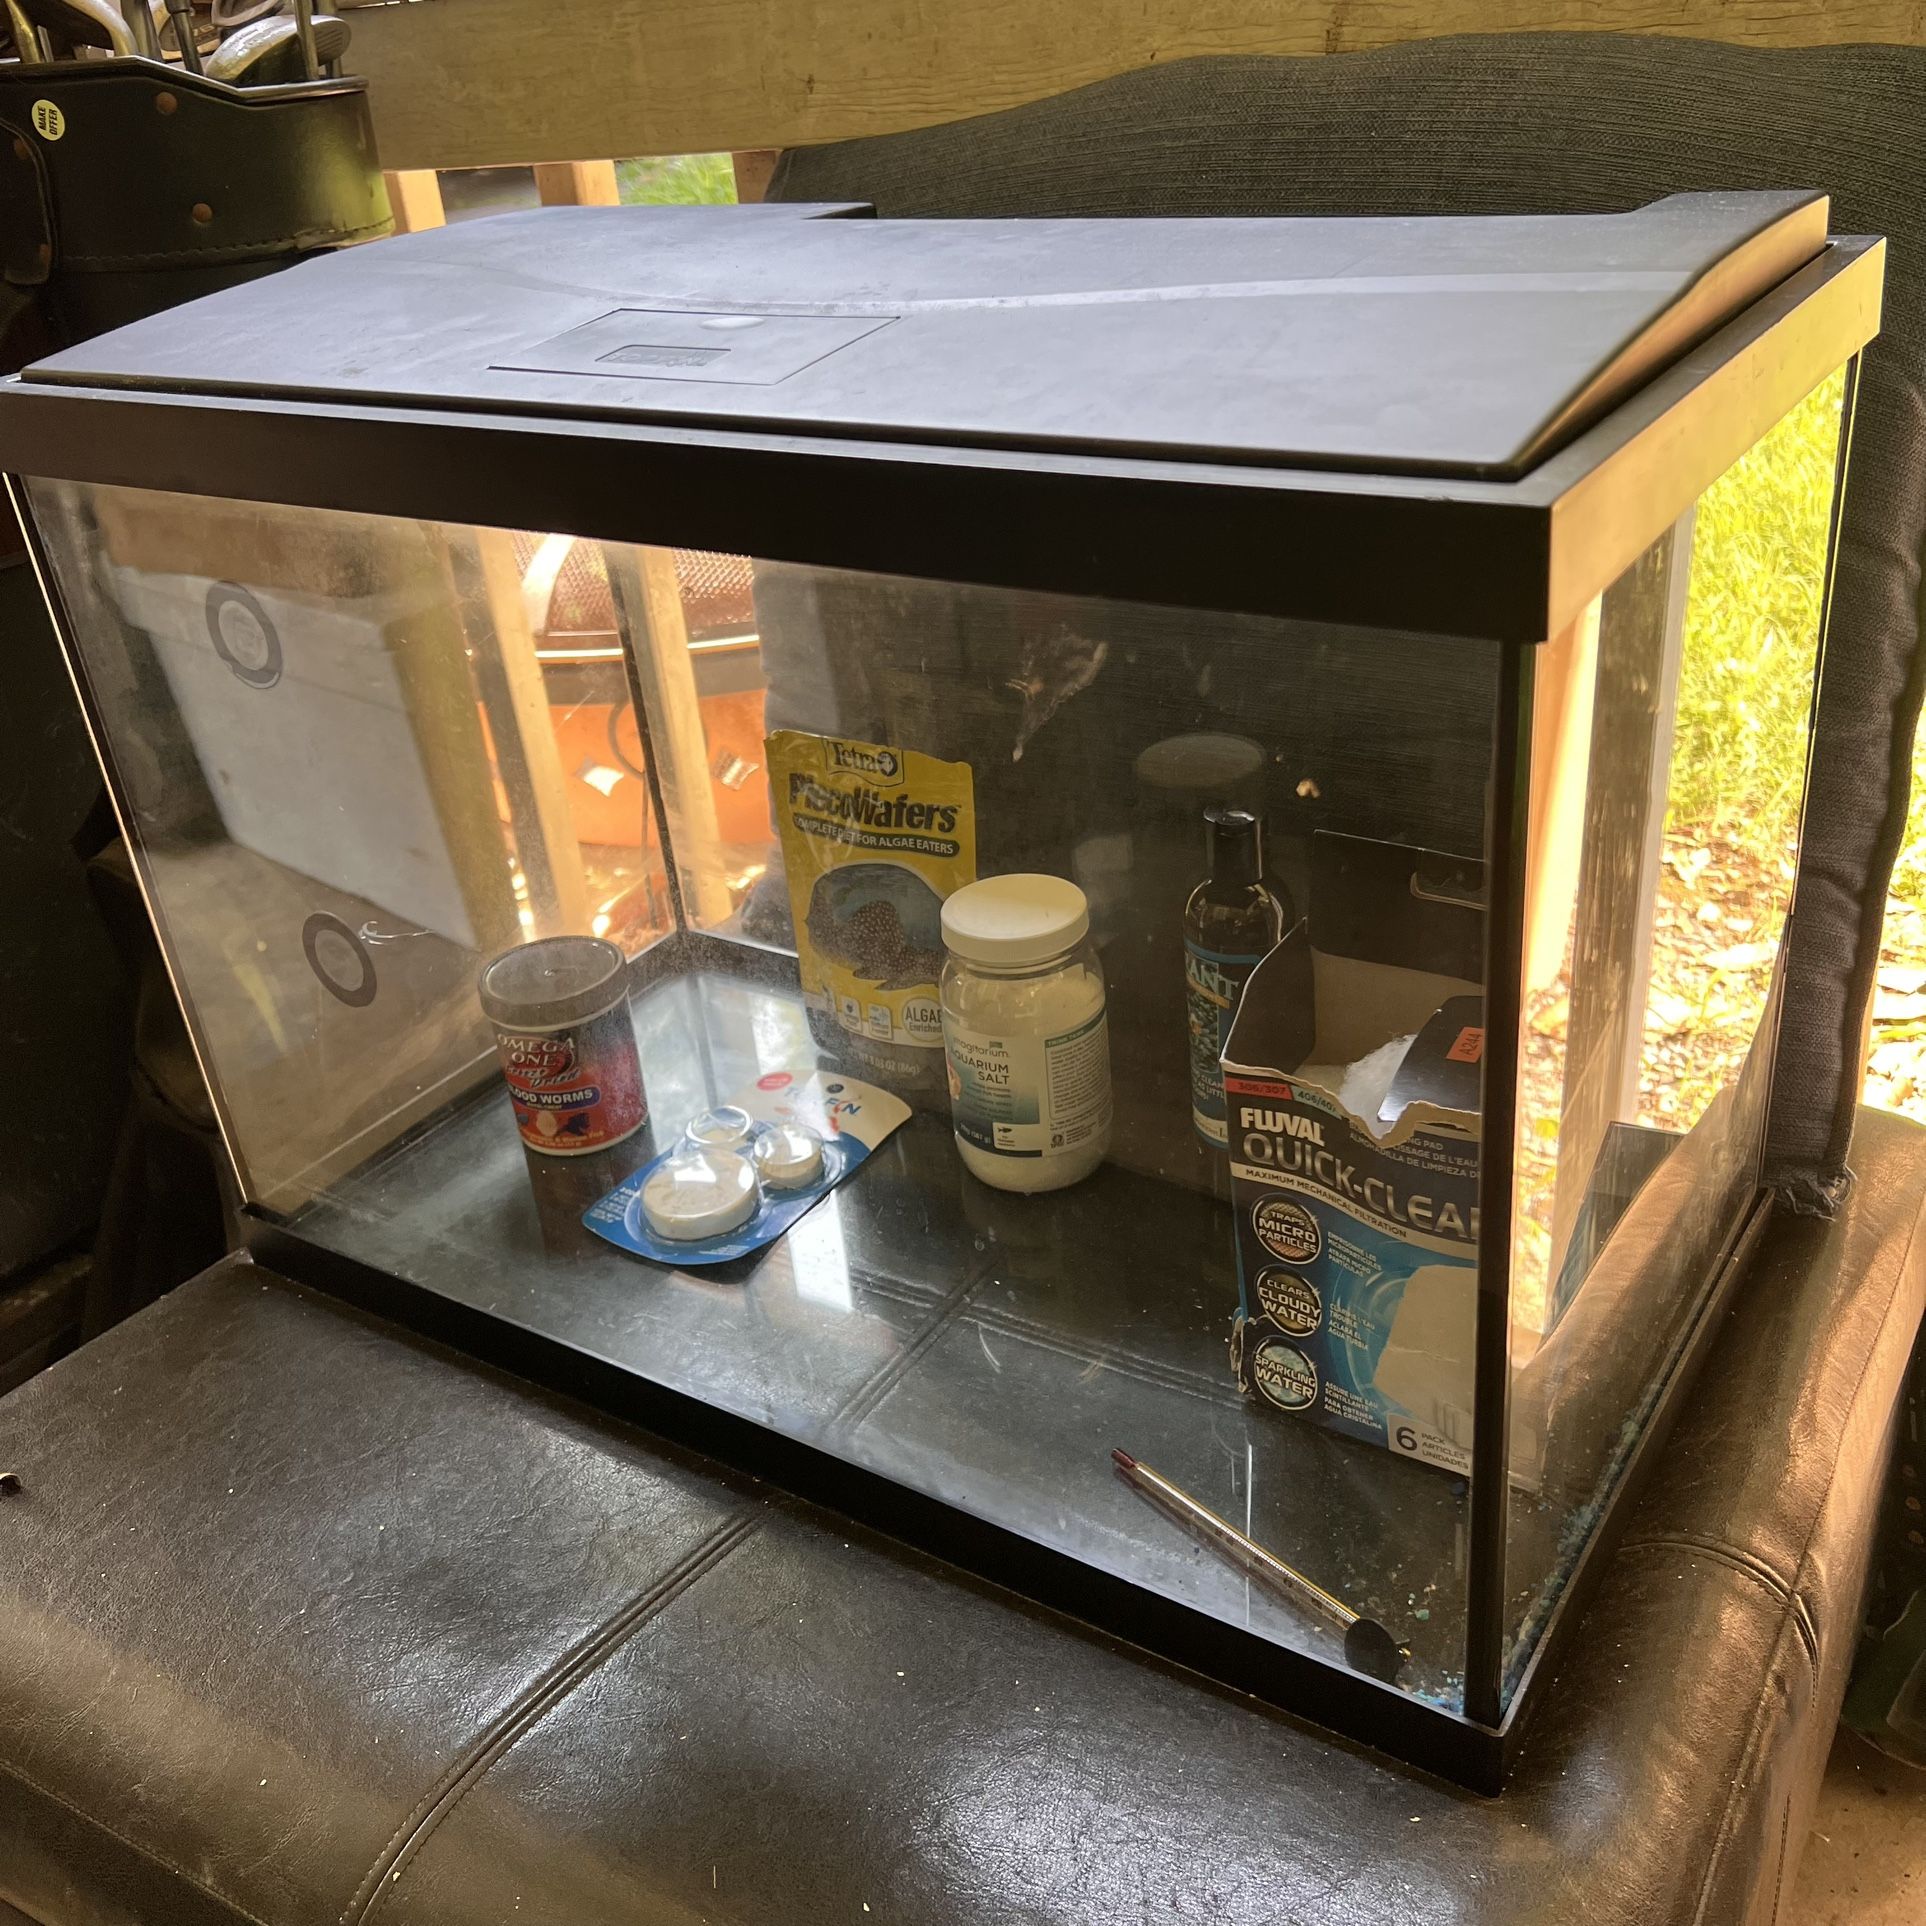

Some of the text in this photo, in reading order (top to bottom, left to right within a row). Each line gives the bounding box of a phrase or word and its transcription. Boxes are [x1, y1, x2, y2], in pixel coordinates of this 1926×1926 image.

[37, 105, 46, 131] MAKE
[49, 108, 58, 136] OFFER
[830, 741, 878, 774] Tetra
[856, 831, 877, 847] FOR
[879, 836, 915, 850] ALGAE
[916, 839, 954, 855] EATERS
[497, 1033, 575, 1053] OMEGA
[1458, 1033, 1482, 1056] A244
[511, 1052, 557, 1067] ONE
[978, 1071, 1010, 1085] SALT
[1237, 1081, 1286, 1095] 306/307
[540, 1088, 593, 1104] WORMS
[1240, 1106, 1325, 1147] FLUVAL
[1423, 1140, 1444, 1151] PAD
[1406, 1157, 1419, 1167] DE
[1421, 1160, 1467, 1177] LIMPIEZA
[1432, 1152, 1447, 1163] DE
[1246, 1168, 1407, 1238] MAXIMUM MECHANICAL FILTRATION
[1271, 1211, 1305, 1226] TRAPS
[1258, 1218, 1317, 1243] MICRO
[1258, 1228, 1317, 1254] PARTICLES
[1266, 1279, 1310, 1300] CLEARS
[1258, 1286, 1322, 1318] CLOUDY
[1261, 1298, 1318, 1331] WATER
[1255, 1354, 1316, 1388] SPARKLING
[1256, 1365, 1313, 1400] WATER
[1324, 1396, 1374, 1421] PARA OBTENER
[1324, 1404, 1343, 1417] AGUA
[1396, 1426, 1445, 1451] 6 PACK
[1422, 1441, 1466, 1460] ARTICLES
[1422, 1450, 1469, 1470] UNIDADES
